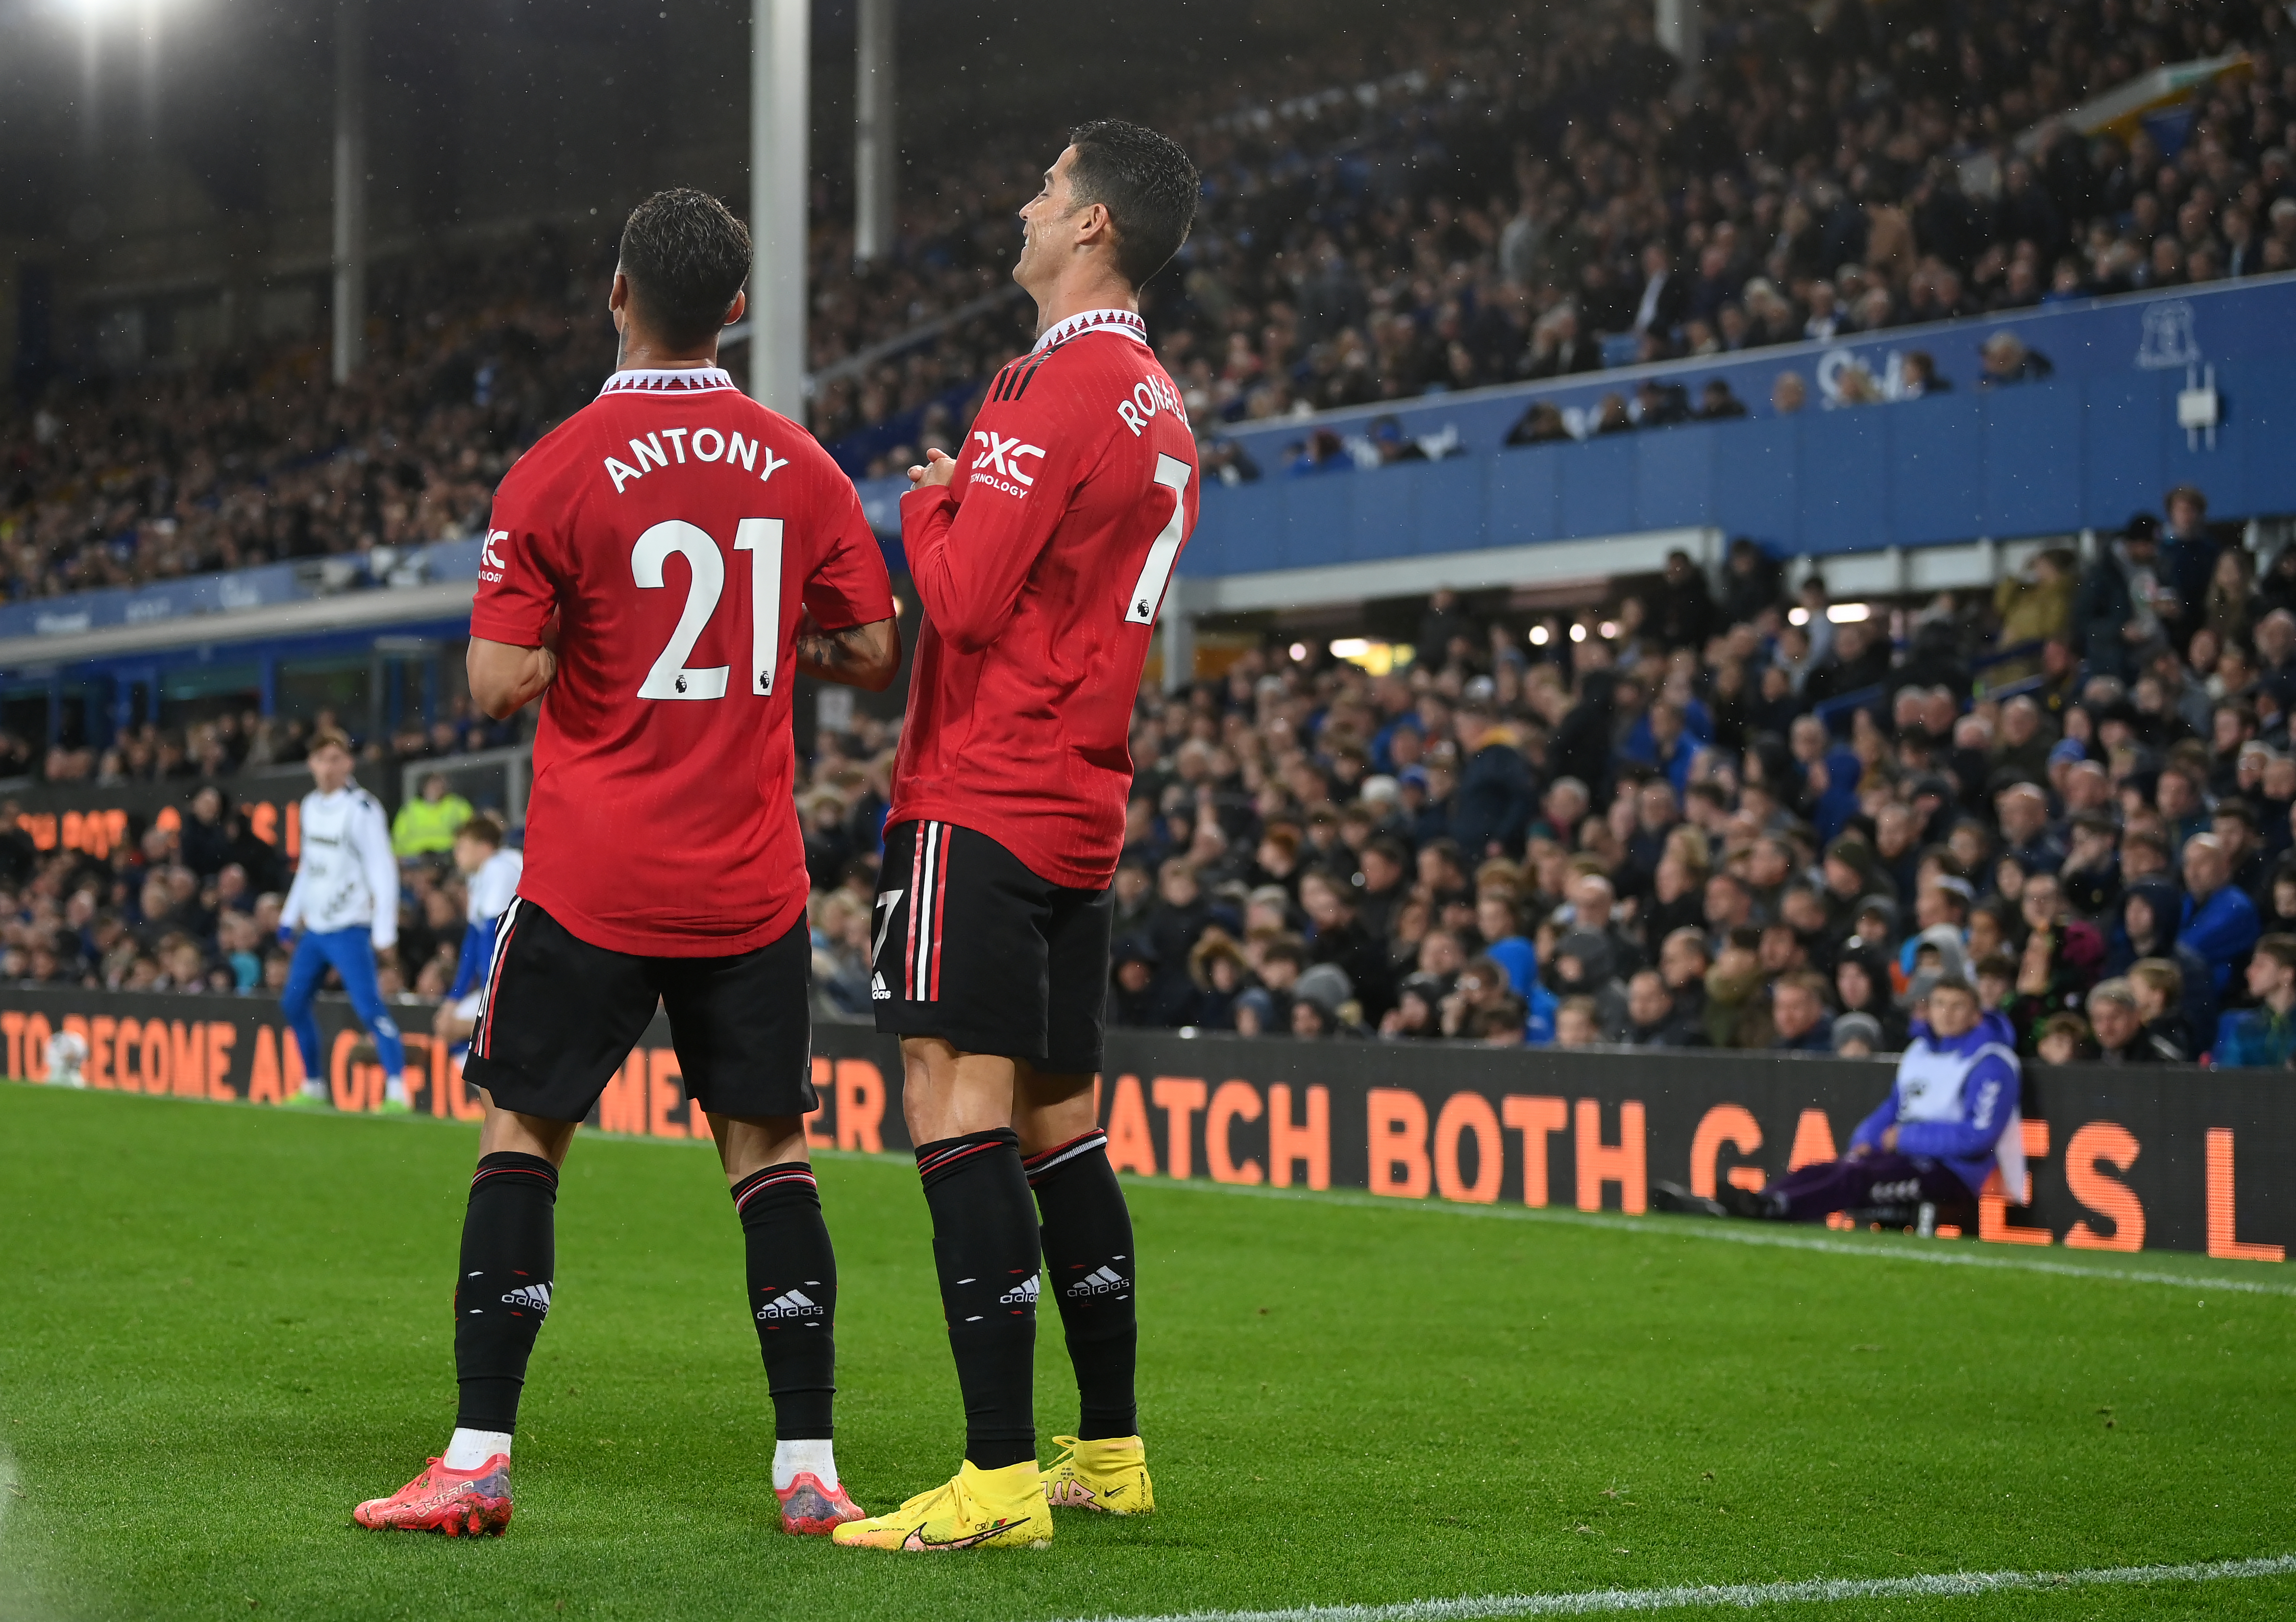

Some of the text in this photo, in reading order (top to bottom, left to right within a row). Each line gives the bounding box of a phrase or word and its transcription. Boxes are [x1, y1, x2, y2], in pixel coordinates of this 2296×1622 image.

[1117, 374, 1192, 437] RONAL
[603, 427, 789, 493] ANTONY
[1123, 452, 1192, 626] 7
[630, 518, 784, 700] 21
[872, 889, 904, 968] 7
[1, 1010, 51, 1083] TO
[599, 1046, 887, 1154] MEER
[1094, 1072, 1331, 1192] ATCH
[1366, 1087, 1647, 1216] BOTH
[1690, 1103, 2146, 1253] GAES
[501, 1294, 548, 1313] adida
[757, 1305, 824, 1319] adidas
[1000, 1291, 1038, 1303] adida
[1067, 1278, 1130, 1297] adidas
